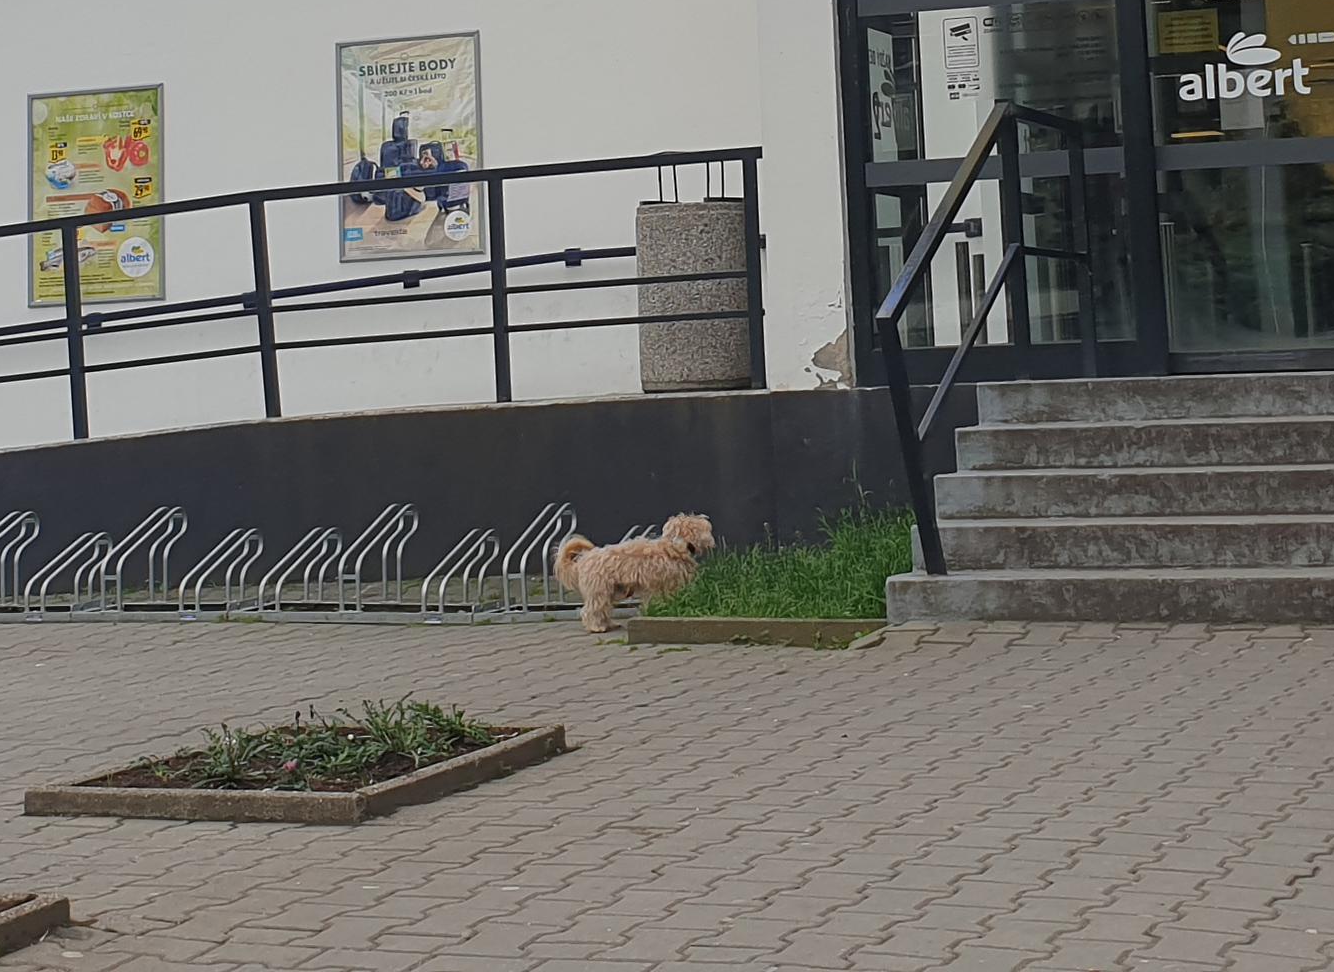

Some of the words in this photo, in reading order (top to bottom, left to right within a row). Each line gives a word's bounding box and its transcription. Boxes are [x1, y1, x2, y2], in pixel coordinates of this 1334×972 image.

[359, 61, 415, 77] SBÍREJTE
[419, 58, 456, 72] BODY
[1178, 58, 1312, 101] albert
[120, 253, 151, 263] albert
